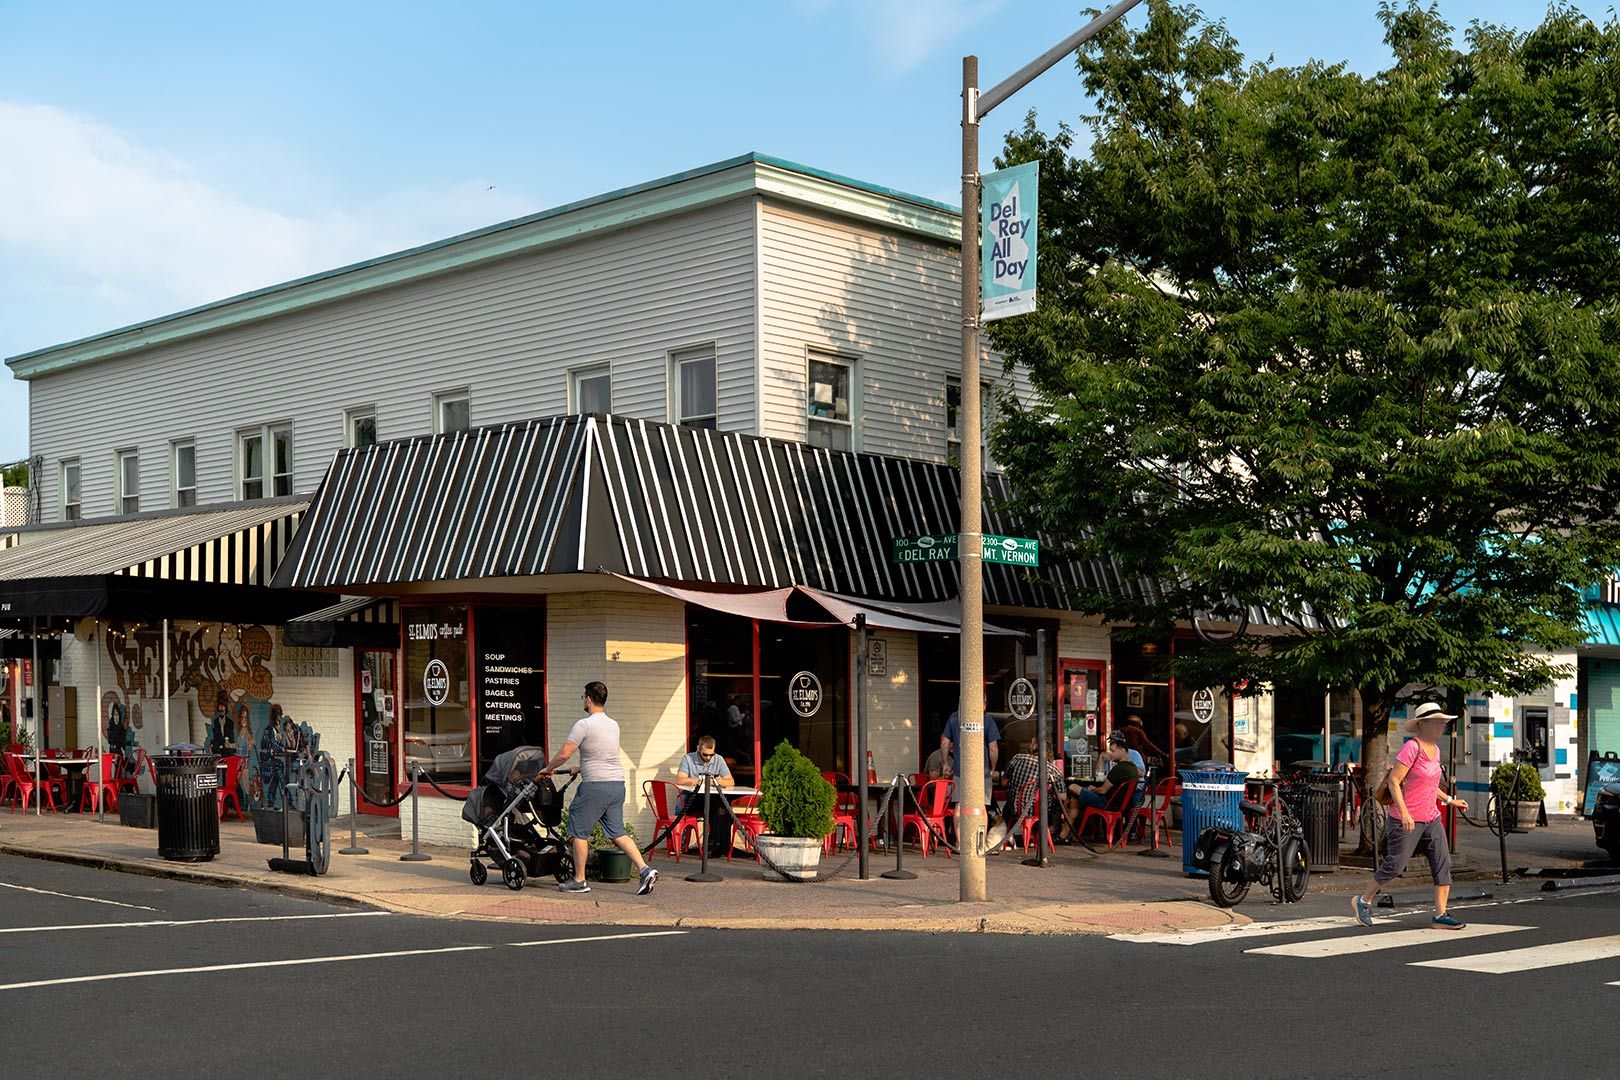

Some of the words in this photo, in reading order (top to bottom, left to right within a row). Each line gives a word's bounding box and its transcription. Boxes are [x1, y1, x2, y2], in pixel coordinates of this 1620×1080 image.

[991, 196, 1016, 221] Del
[999, 218, 1031, 239] Ray
[991, 237, 1011, 261] All
[995, 259, 1029, 280] Day
[895, 539, 909, 547] 100
[943, 535, 957, 544] AVE
[982, 538, 998, 546] 2300
[1024, 541, 1036, 550] AVE
[904, 549, 925, 561] DEL
[928, 547, 951, 560] RAY
[983, 547, 998, 560] MT.
[1001, 549, 1036, 564] VERNON
[415, 623, 438, 640] ELMO'S
[485, 665, 533, 674] SANDWICHES
[485, 677, 520, 685] PASTRIES
[485, 689, 514, 697] BAGELS
[485, 701, 522, 709] CATERING
[485, 713, 522, 722] MEETINGS
